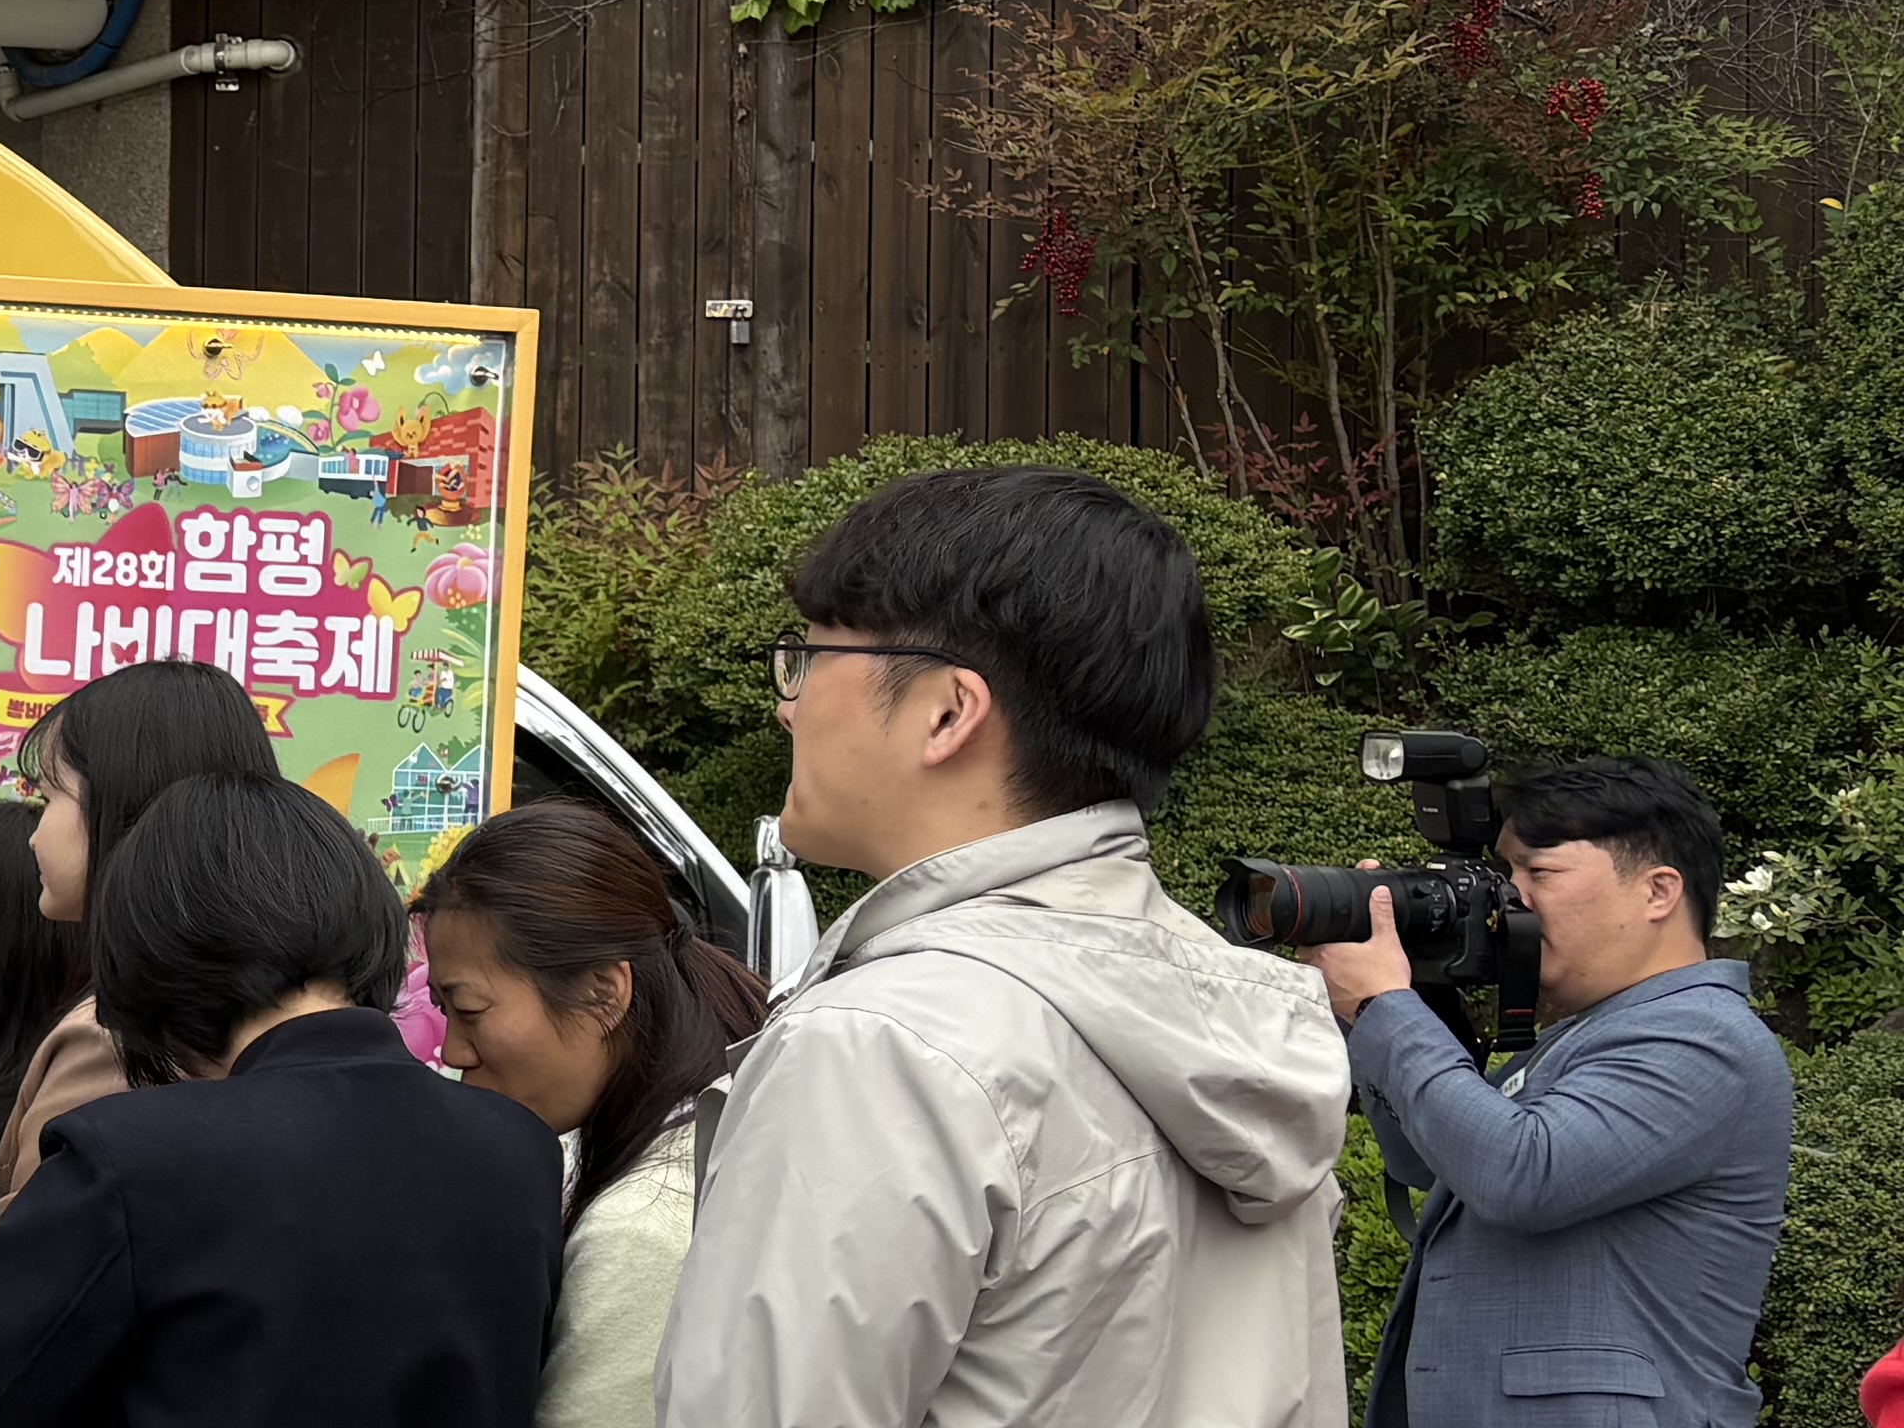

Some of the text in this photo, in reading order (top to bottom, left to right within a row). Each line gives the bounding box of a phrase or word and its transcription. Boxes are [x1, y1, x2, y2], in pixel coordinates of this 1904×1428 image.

[52, 512, 327, 598] 제28회 함평
[23, 601, 398, 695] 나비대축제
